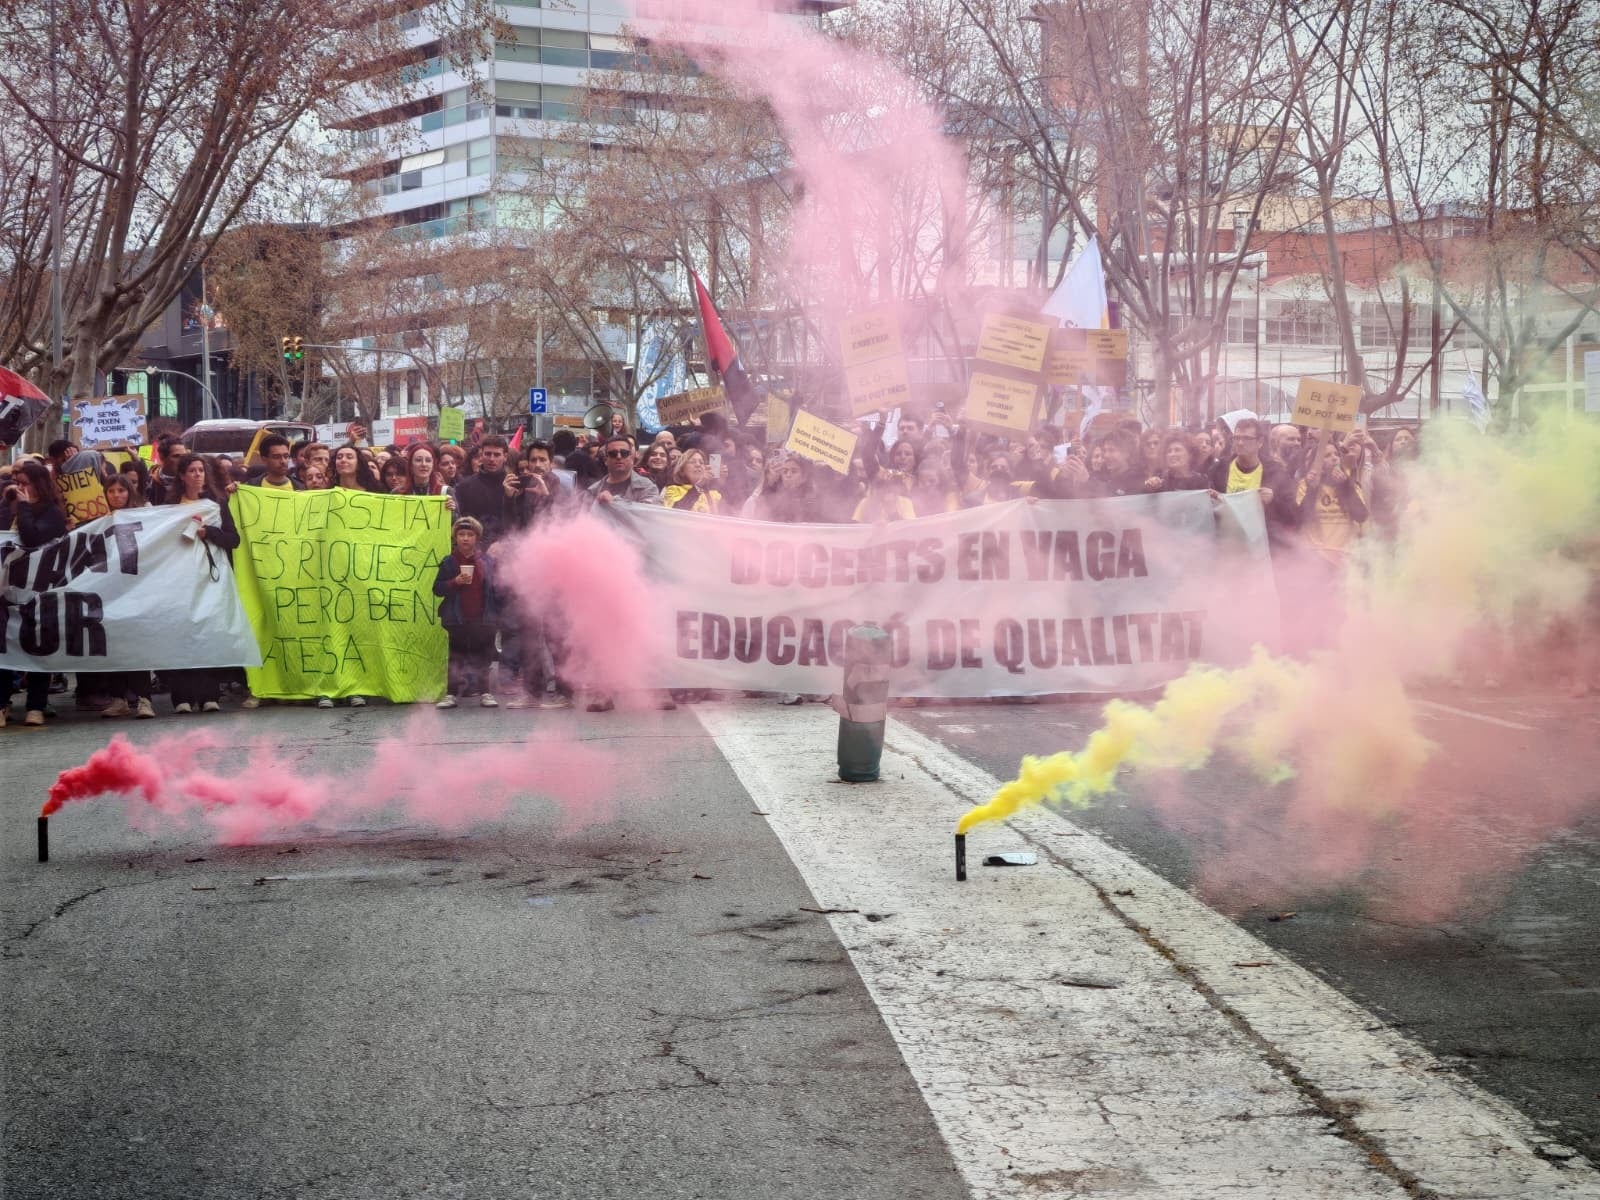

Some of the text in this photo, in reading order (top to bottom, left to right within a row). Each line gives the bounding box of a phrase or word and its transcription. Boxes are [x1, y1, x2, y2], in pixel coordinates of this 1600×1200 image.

[1297, 406, 1312, 415] NO
[1315, 409, 1334, 418] POT
[238, 488, 447, 535] DIVERSITAT
[250, 535, 441, 583] ÉS RIQUESA
[730, 528, 1149, 589] DOCENTS EN VAGA
[275, 583, 436, 626] PERÒ BEN
[925, 617, 983, 670] DE
[993, 609, 1207, 675] QUALITAT
